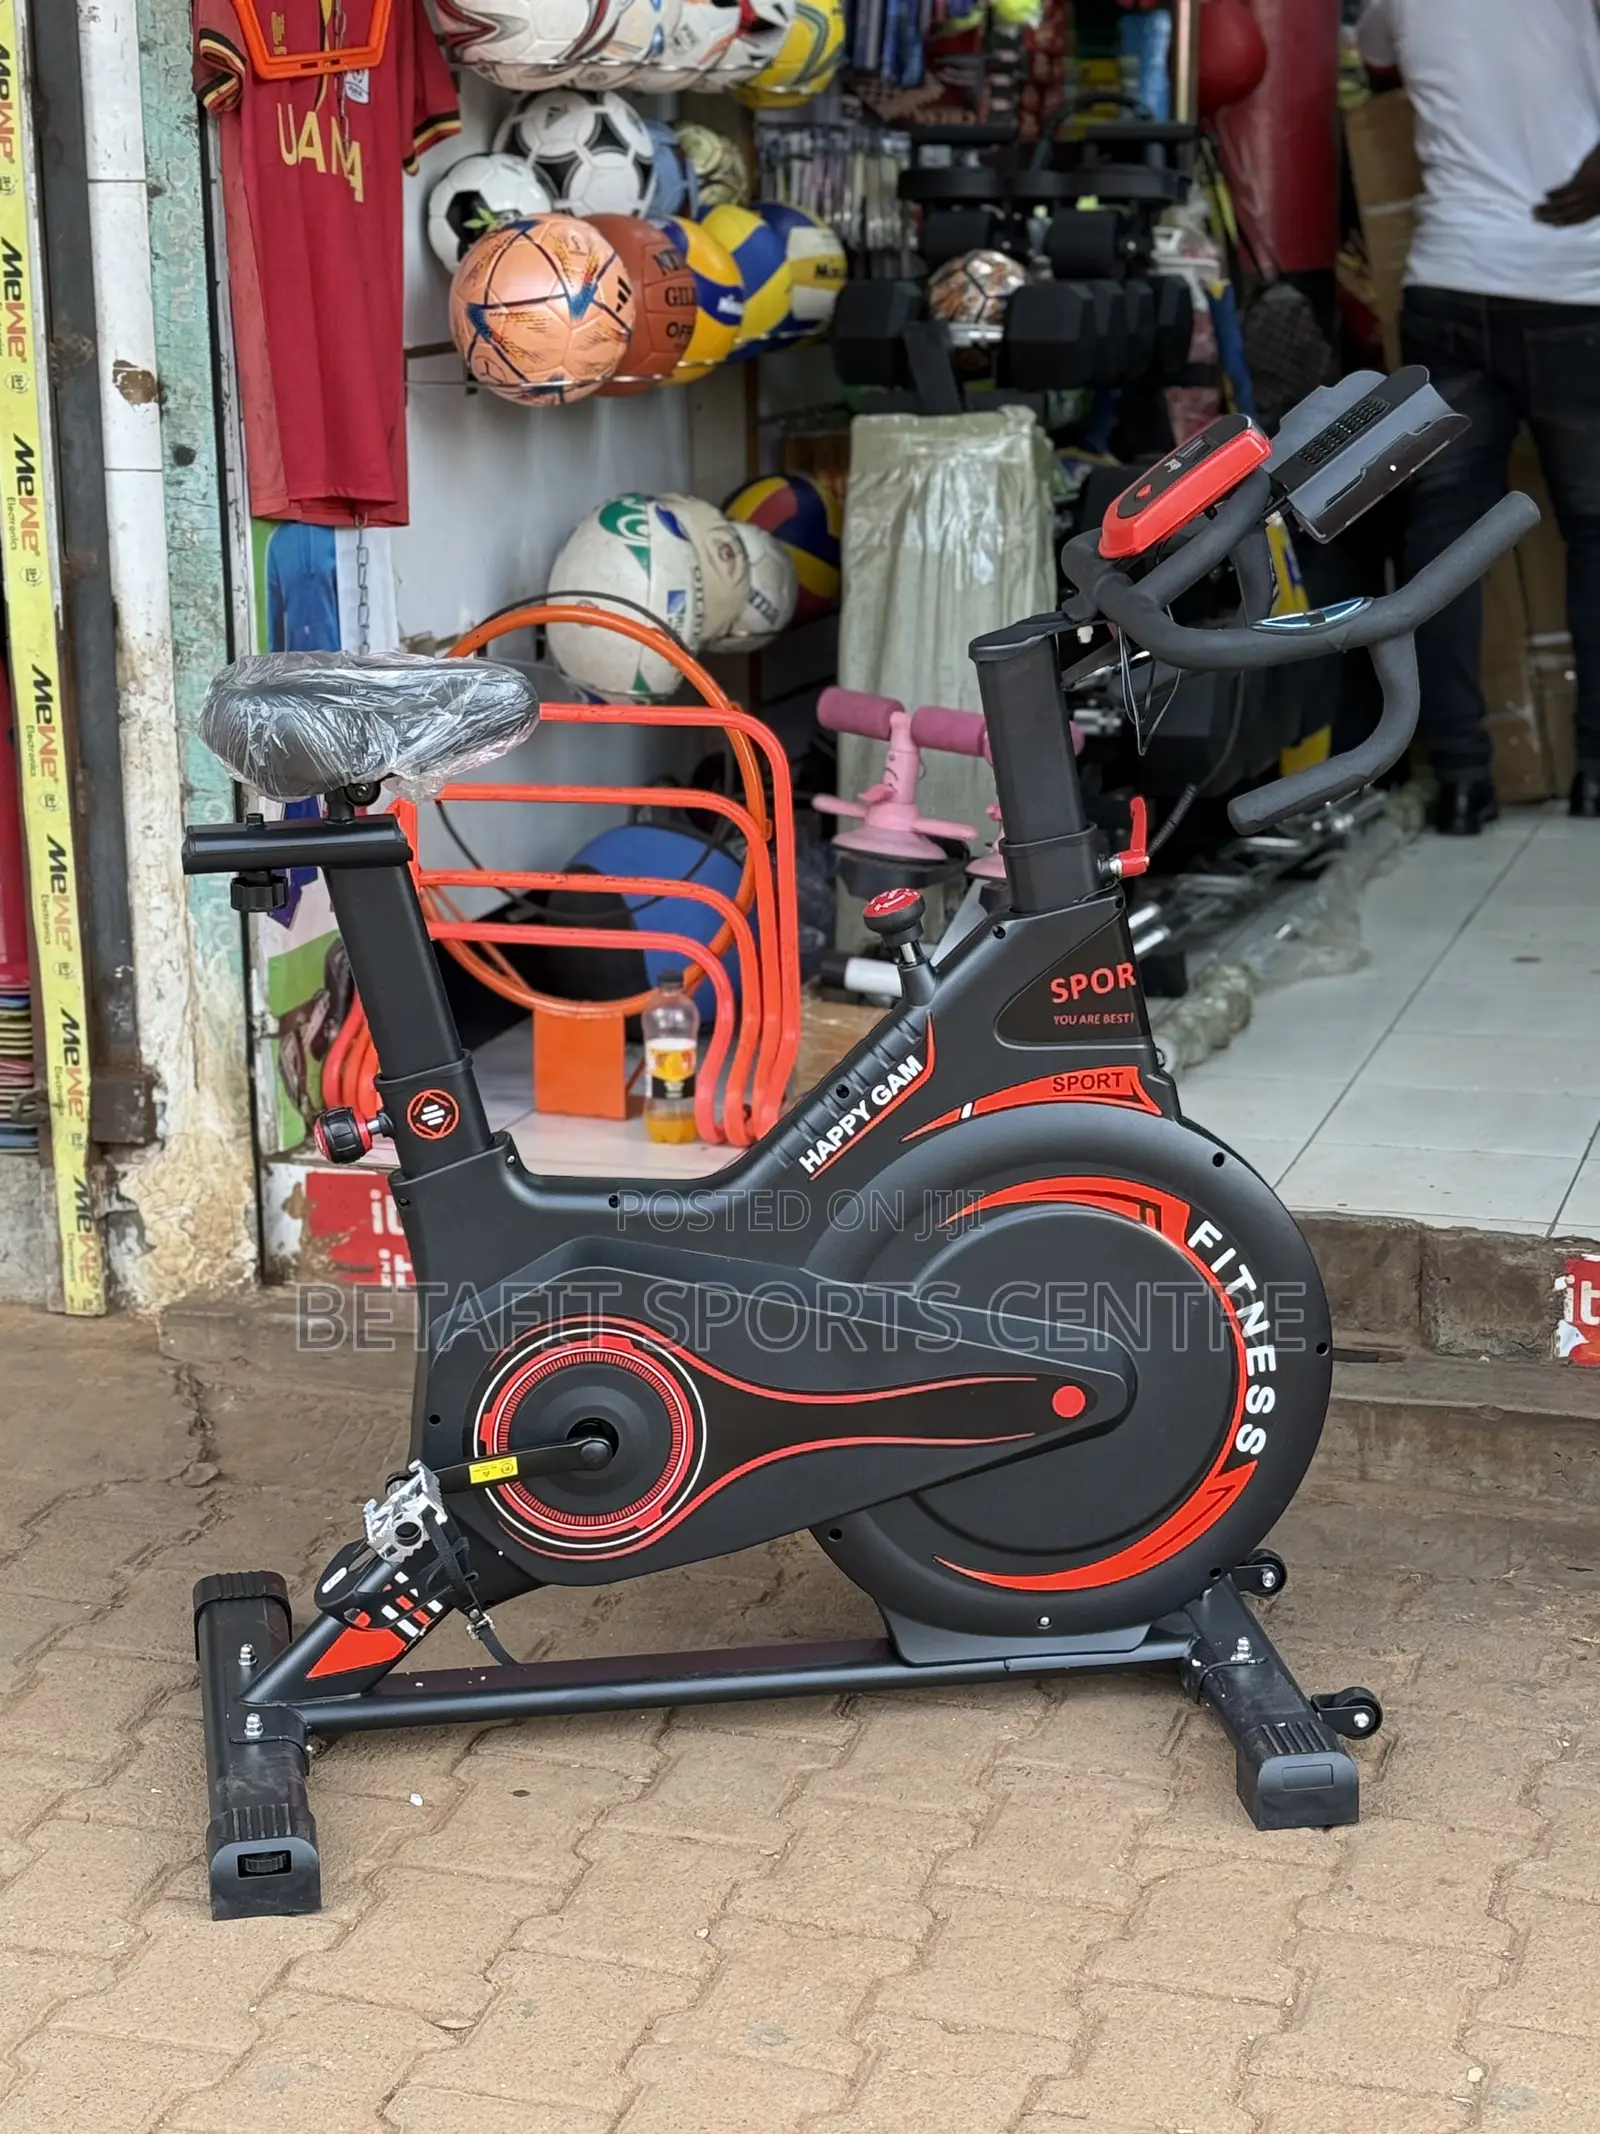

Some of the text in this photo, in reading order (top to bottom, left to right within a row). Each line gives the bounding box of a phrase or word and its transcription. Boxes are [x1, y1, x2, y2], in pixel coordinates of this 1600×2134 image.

[1, 236, 27, 361] MeWe
[7, 496, 17, 550] Electronics
[13, 433, 40, 552] MeWe
[26, 725, 36, 777] Electronics
[31, 663, 58, 778] MeWe
[41, 894, 51, 944] Electronics
[46, 834, 72, 947] MeWe
[1050, 962, 1136, 1004] SPOR
[1053, 1012, 1134, 1025] YOU ARE BEST!
[60, 1007, 85, 1117] MeWe
[799, 1055, 923, 1173] HAPPY GAM
[1052, 1071, 1124, 1093] SPORT
[1187, 1220, 1276, 1454] FITNESS
